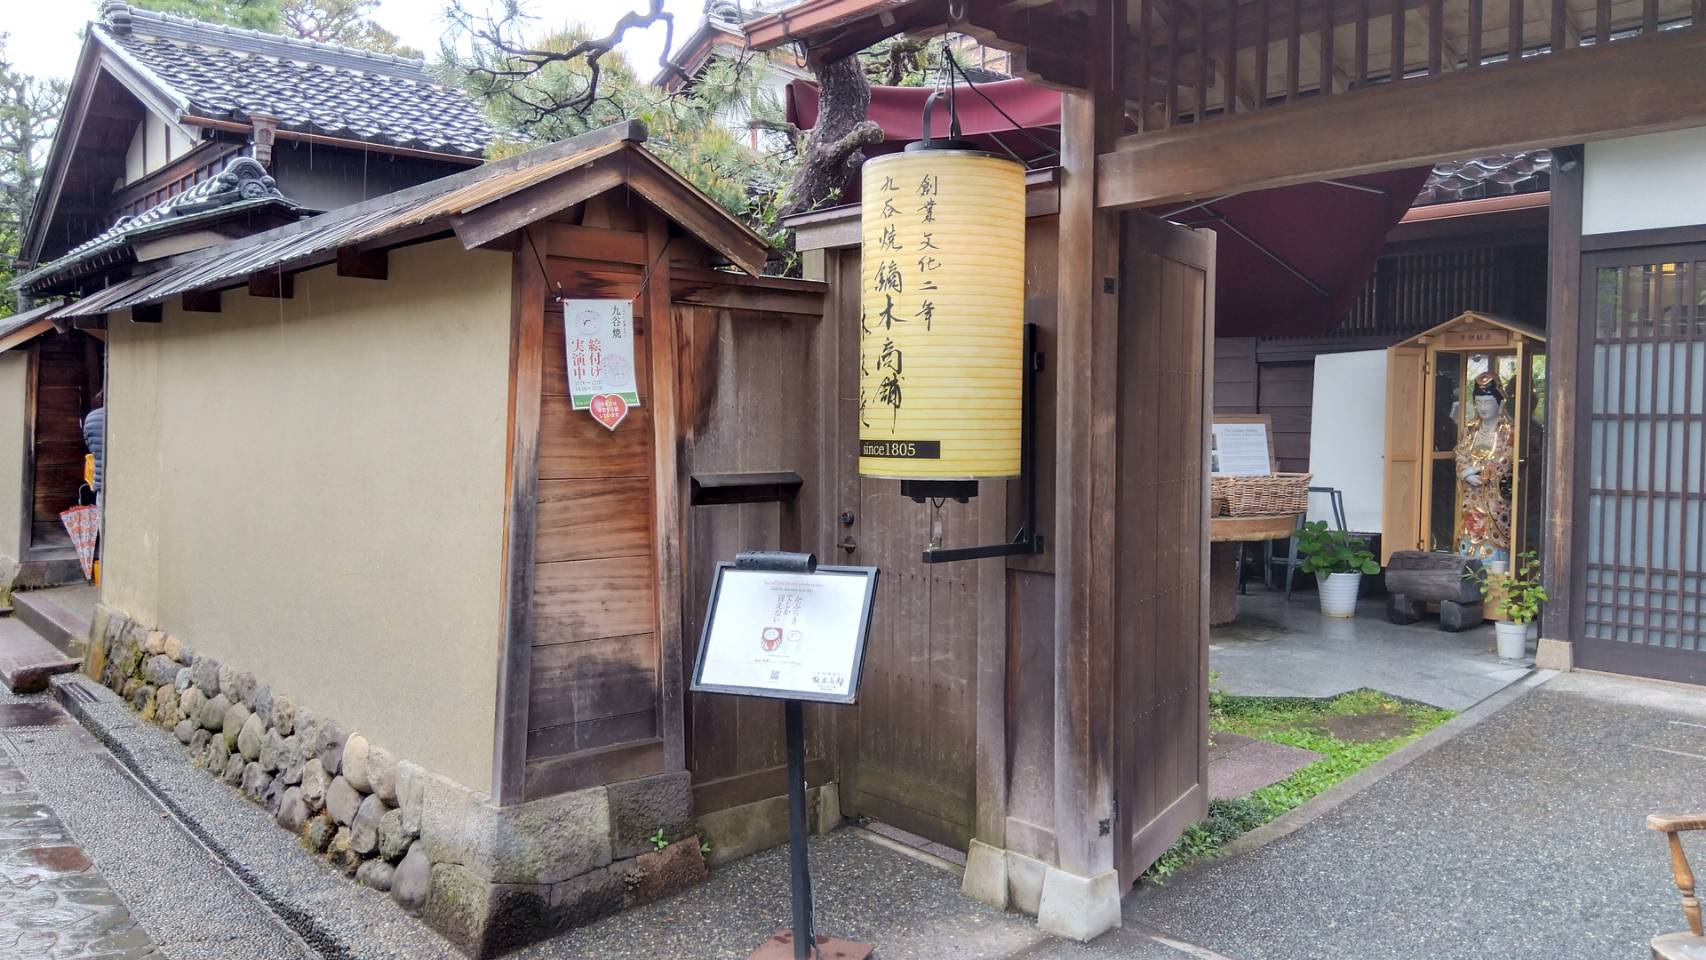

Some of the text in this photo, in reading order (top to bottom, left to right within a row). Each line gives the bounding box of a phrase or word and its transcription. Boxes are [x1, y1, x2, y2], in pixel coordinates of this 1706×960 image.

[611, 304, 622, 339] 九谷焼
[571, 338, 586, 380] 実演中
[588, 338, 602, 378] 絵付け
[862, 442, 916, 458] since1805
